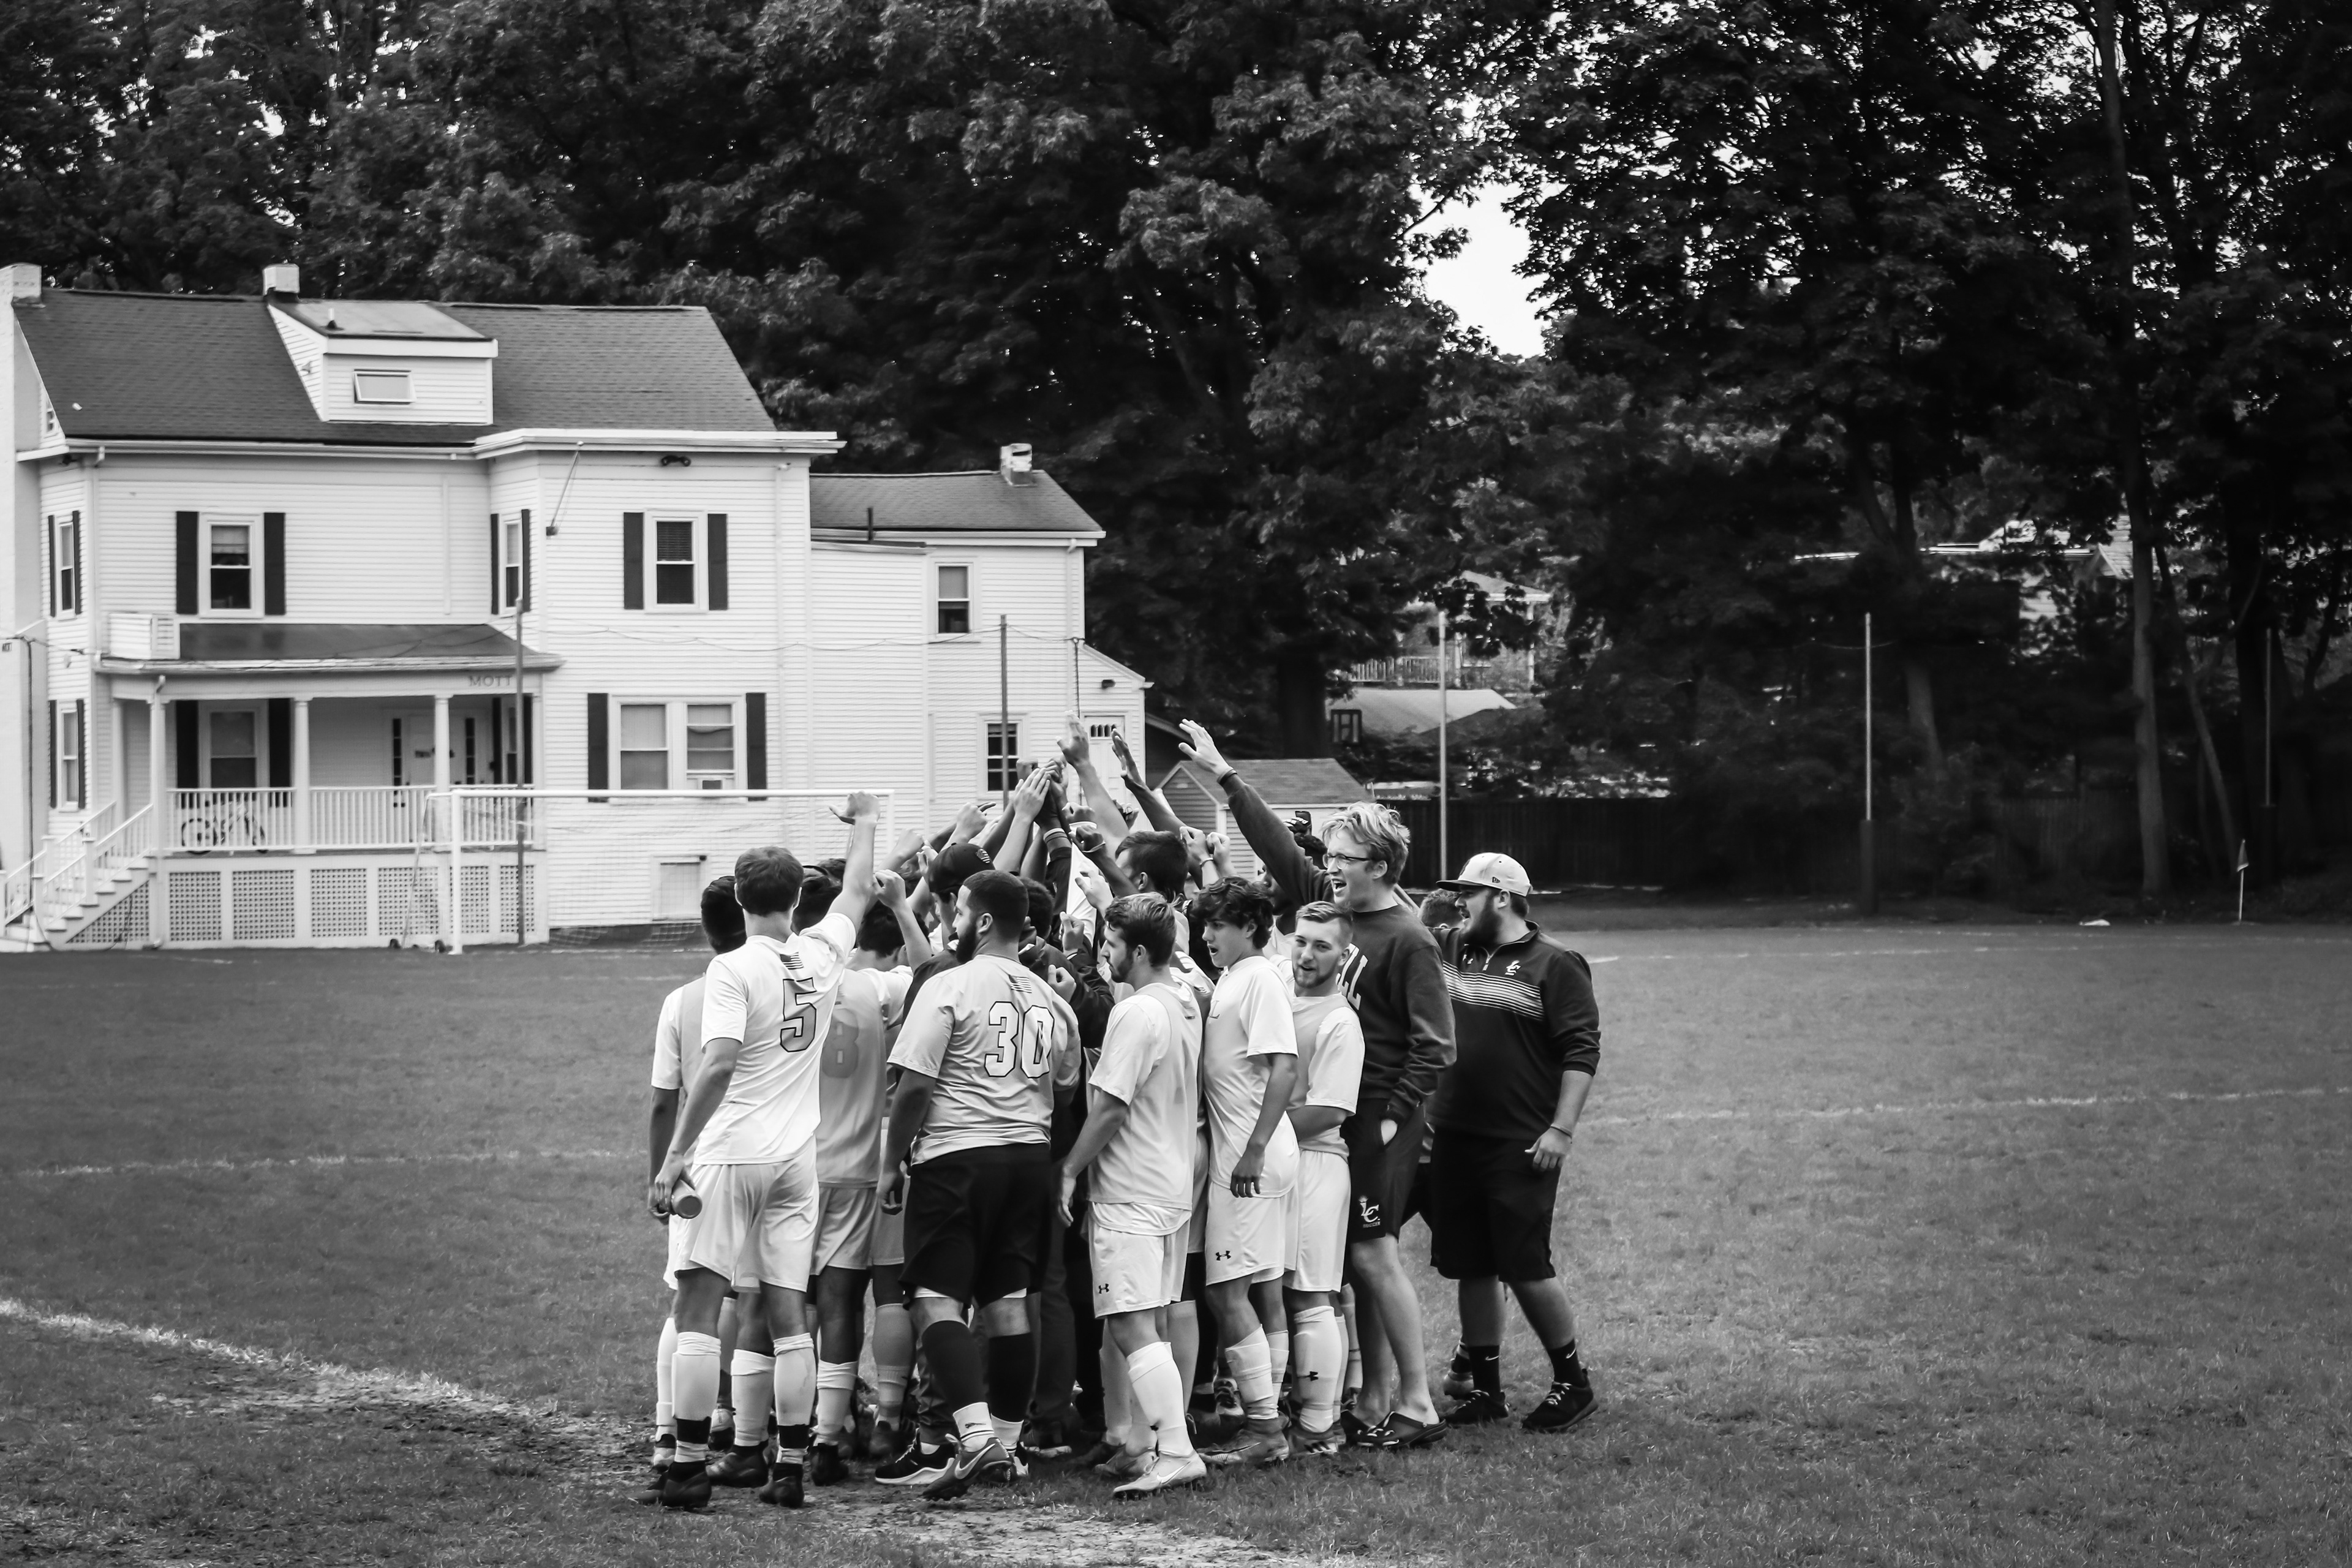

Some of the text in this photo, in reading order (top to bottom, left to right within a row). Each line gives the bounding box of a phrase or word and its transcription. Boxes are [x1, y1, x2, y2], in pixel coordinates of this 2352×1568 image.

[469, 675, 512, 687] MOTT
[1336, 943, 1368, 1011] LL
[780, 977, 817, 1052] 5
[821, 1008, 859, 1078] 8
[984, 1001, 1055, 1078] 30
